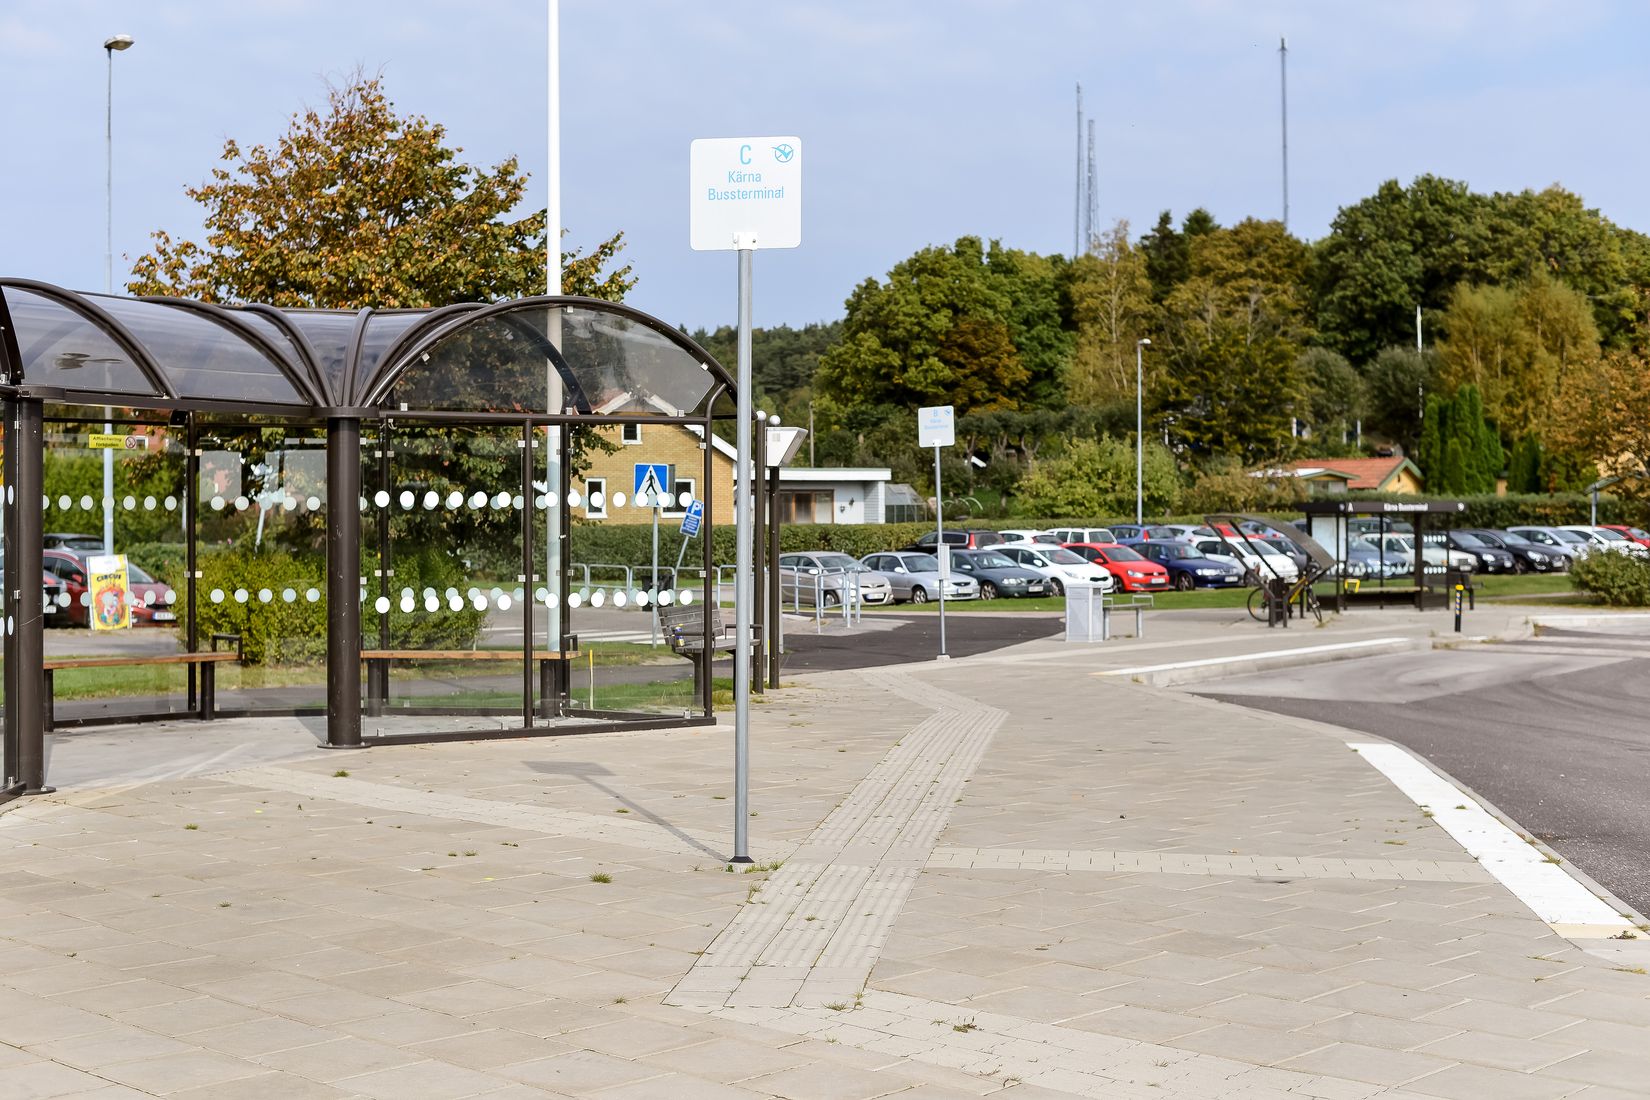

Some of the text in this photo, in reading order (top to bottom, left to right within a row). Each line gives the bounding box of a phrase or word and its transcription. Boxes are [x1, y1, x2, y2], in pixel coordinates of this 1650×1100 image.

[740, 144, 752, 165] C
[728, 170, 762, 183] Kärna
[707, 185, 785, 201] Bussterminal
[690, 500, 701, 514] P
[1347, 502, 1354, 512] A
